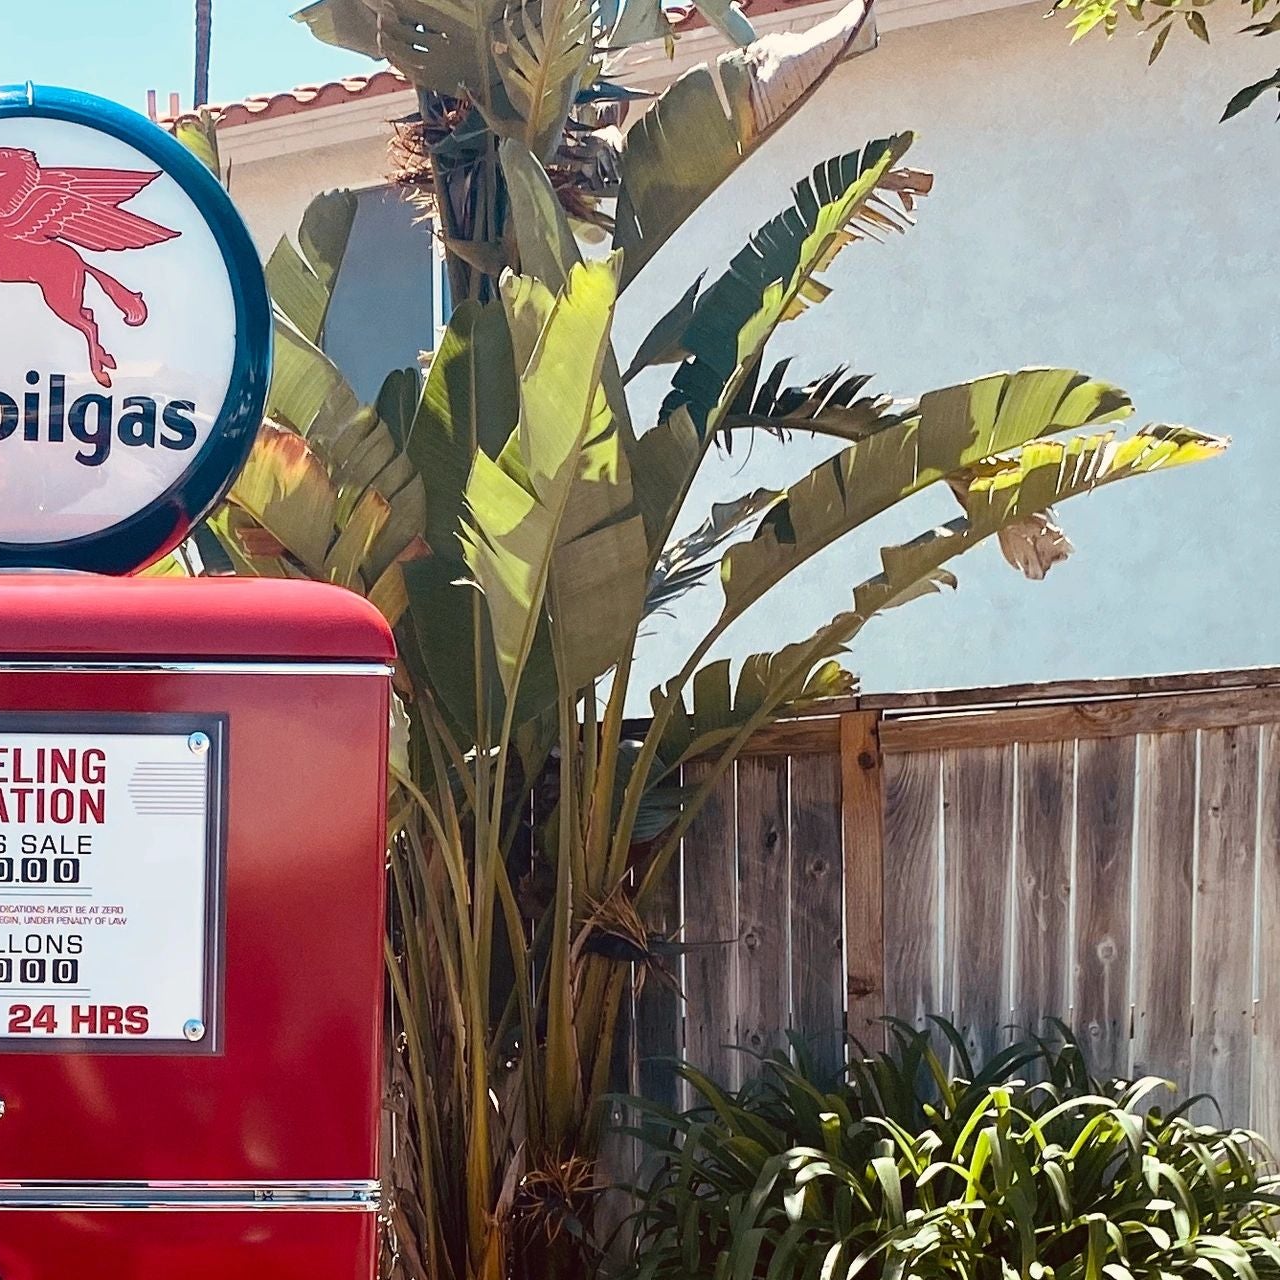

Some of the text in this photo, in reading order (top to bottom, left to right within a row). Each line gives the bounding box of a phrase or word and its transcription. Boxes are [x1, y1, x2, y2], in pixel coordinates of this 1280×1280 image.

[20, 834, 93, 855] SALE
[47, 905, 73, 914] MUST
[75, 905, 87, 914] BE
[88, 905, 99, 914] AT
[101, 905, 124, 915] ZERO
[23, 916, 54, 925] UNDER
[56, 916, 93, 925] PENALTY
[94, 917, 107, 926] OF
[108, 917, 128, 926] LAW
[7, 1004, 58, 1034] 24
[71, 1004, 150, 1035] HRS
